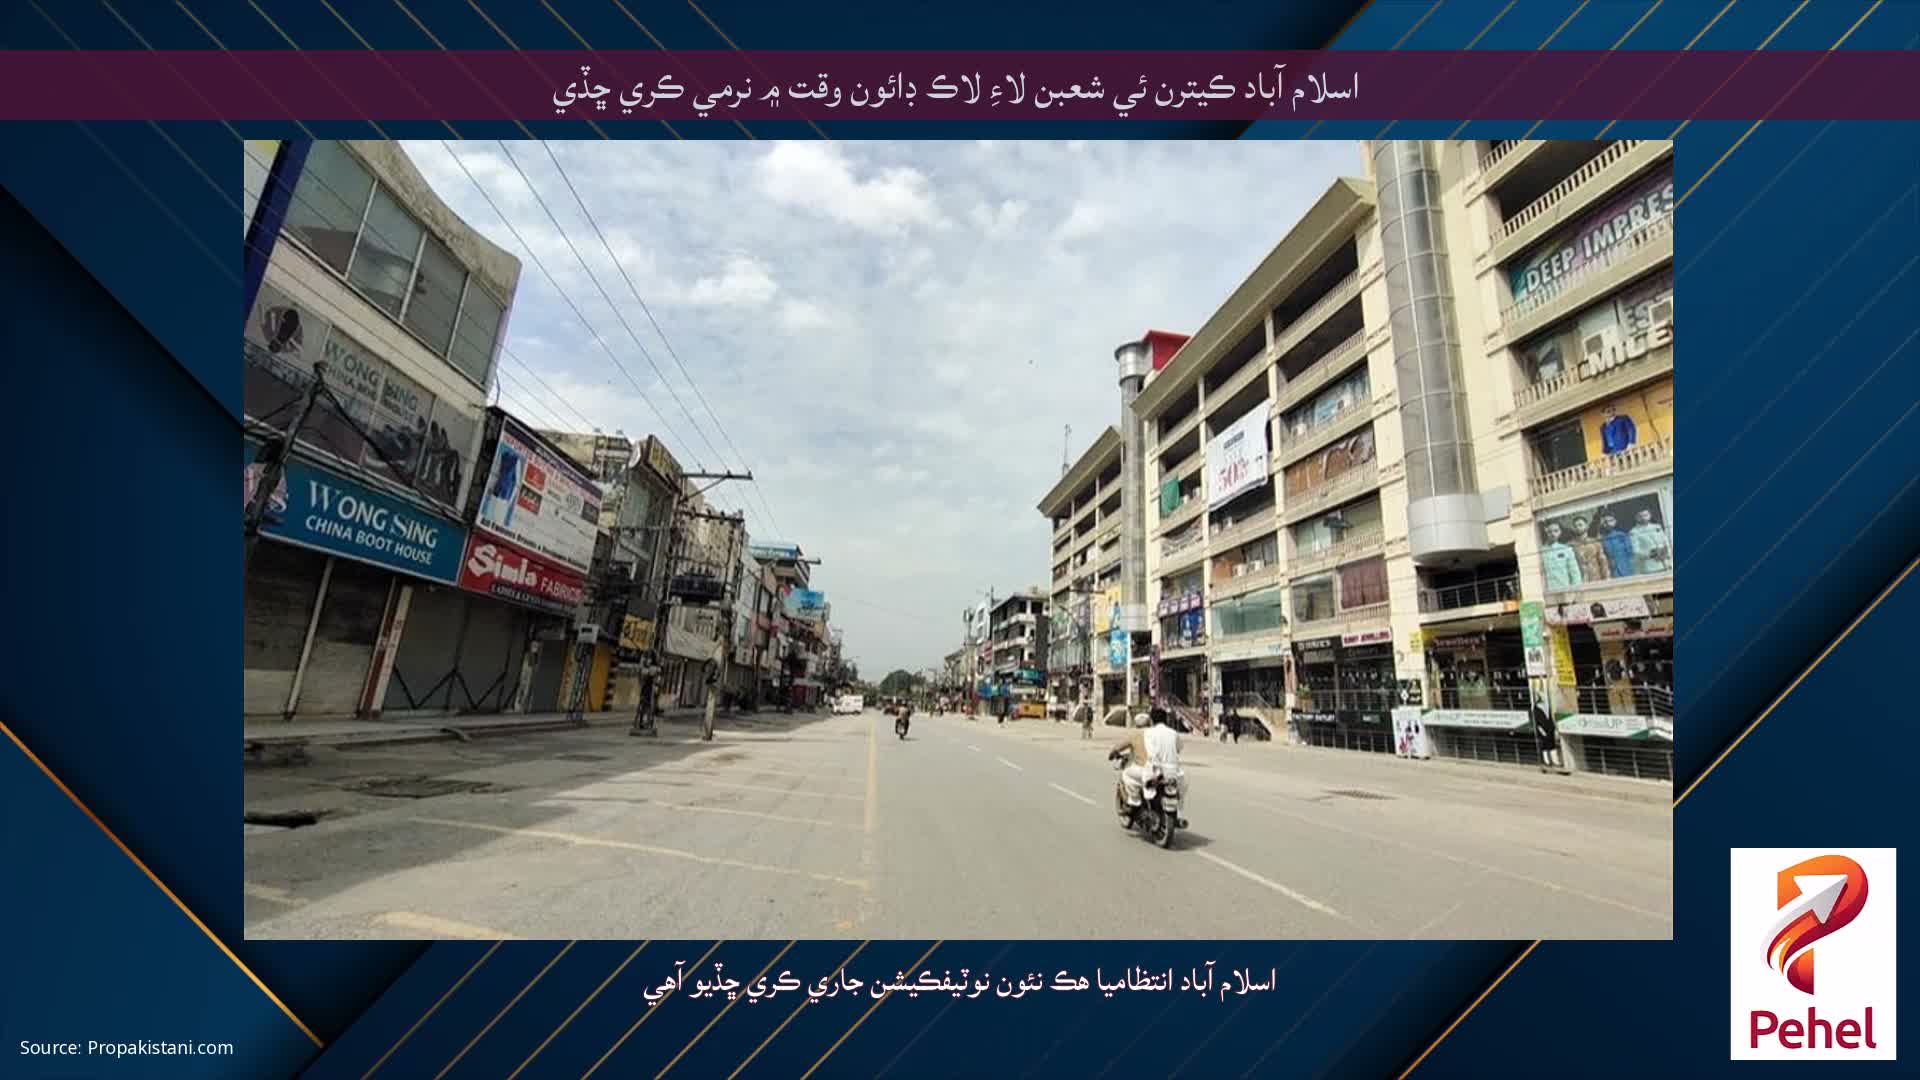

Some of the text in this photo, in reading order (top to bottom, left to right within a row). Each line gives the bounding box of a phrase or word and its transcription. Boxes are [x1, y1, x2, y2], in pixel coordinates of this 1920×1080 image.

[1526, 247, 1575, 292] DEEP
[309, 479, 439, 549] WONG SING
[305, 515, 432, 565] CHINA BOOT HOUSE
[468, 543, 537, 587] Simla
